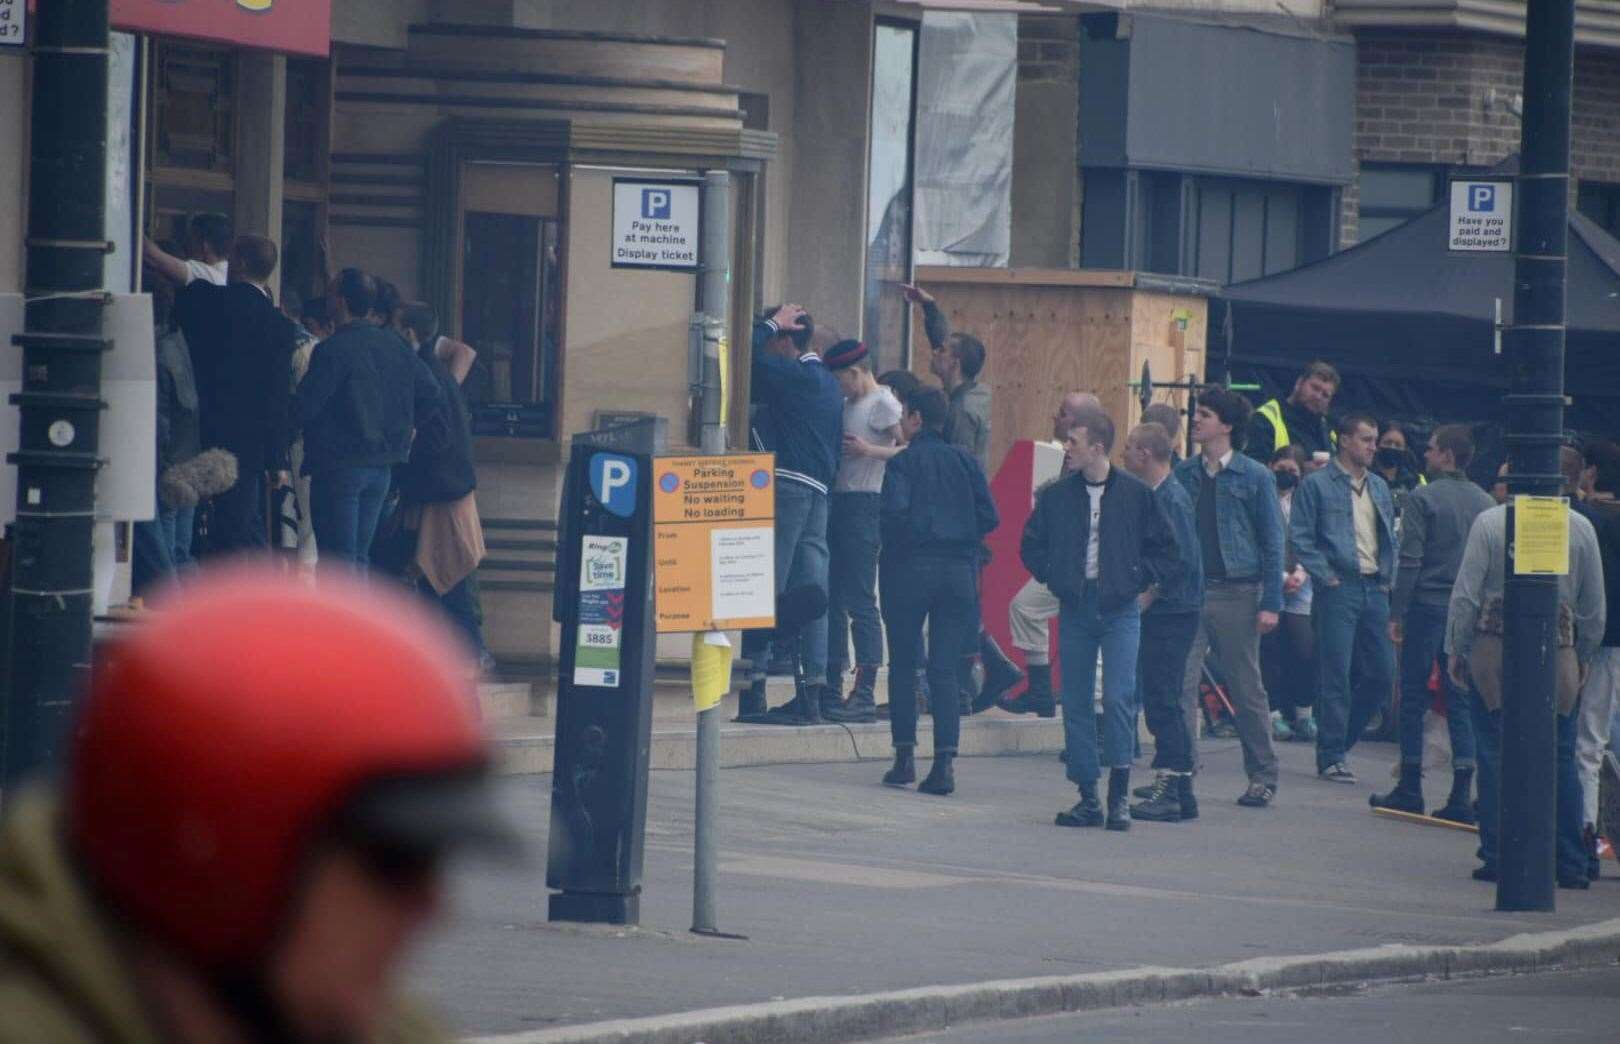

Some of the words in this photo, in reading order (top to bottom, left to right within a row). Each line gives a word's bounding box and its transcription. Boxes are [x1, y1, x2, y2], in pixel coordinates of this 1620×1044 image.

[648, 192, 667, 216] P
[1474, 188, 1491, 210] P
[632, 221, 652, 233] Pay
[655, 222, 680, 233] here
[1458, 216, 1482, 225] Have
[1486, 217, 1504, 227] you
[1459, 227, 1480, 237] paid
[1483, 227, 1502, 236] and
[624, 234, 636, 243] at
[640, 234, 686, 245] machine
[617, 248, 658, 260] Display
[662, 249, 693, 261] ticket
[694, 468, 734, 478] Parking
[601, 460, 631, 504] P
[684, 479, 745, 490] Suspension
[684, 496, 700, 505] No
[703, 495, 745, 505] waiting
[684, 509, 700, 518] No
[703, 508, 745, 518] loading
